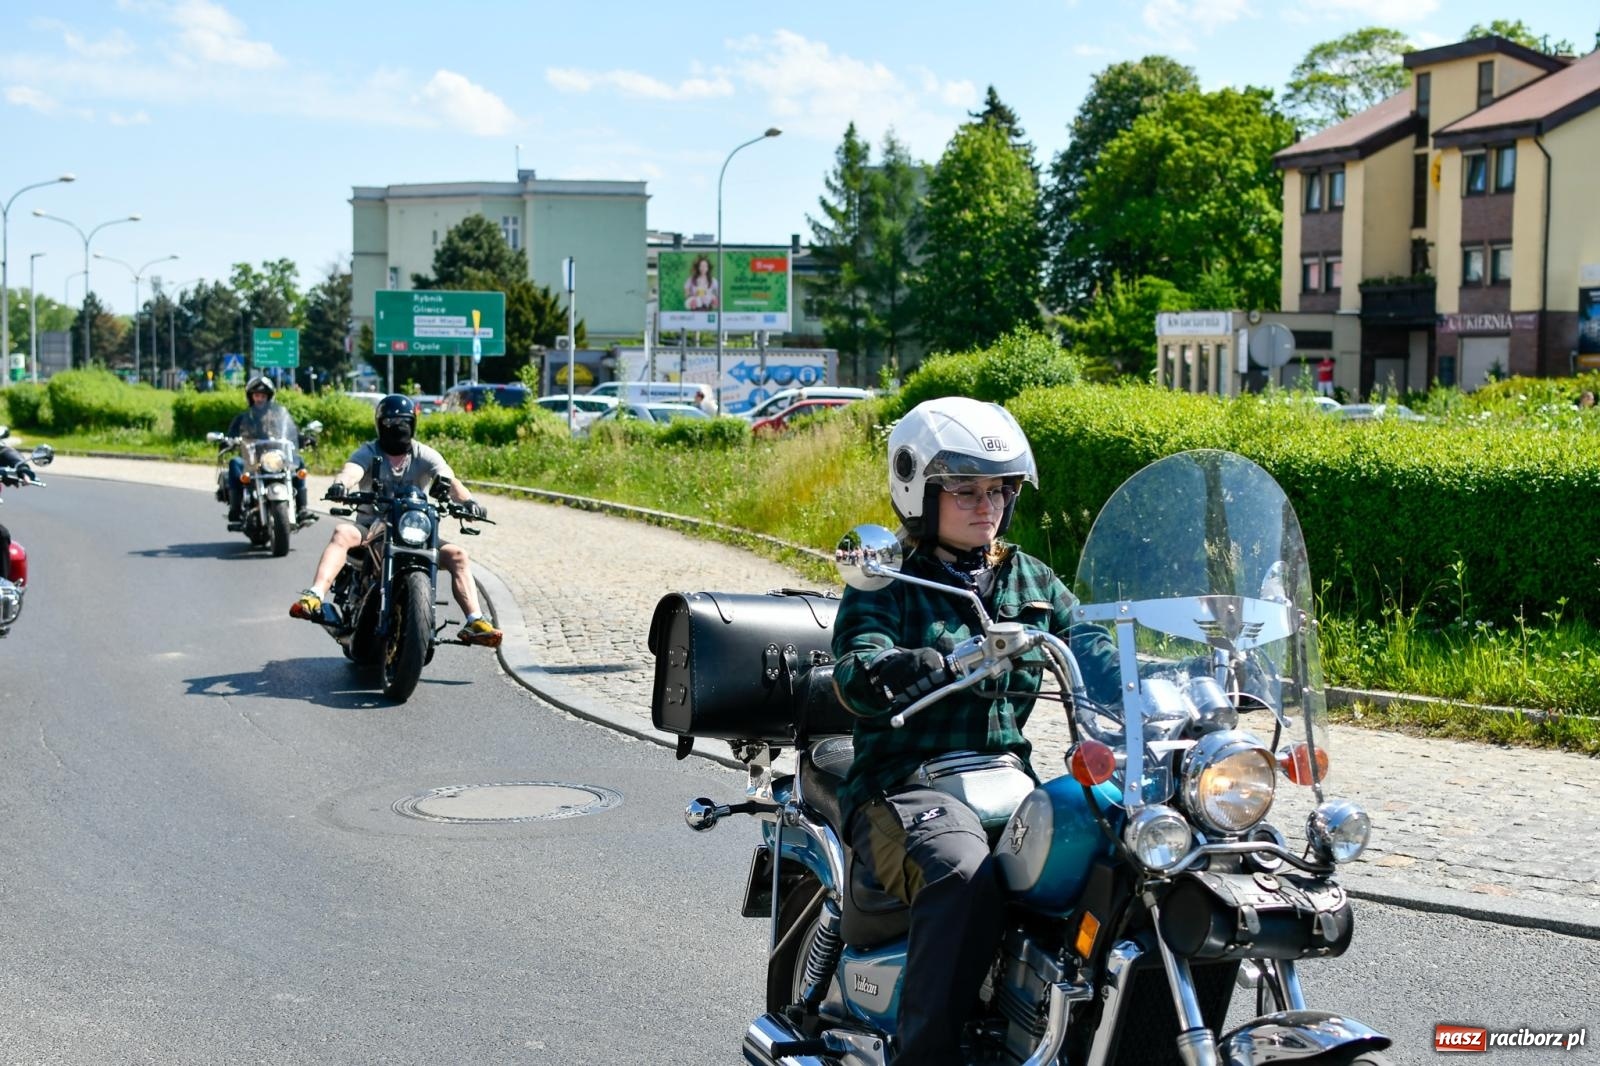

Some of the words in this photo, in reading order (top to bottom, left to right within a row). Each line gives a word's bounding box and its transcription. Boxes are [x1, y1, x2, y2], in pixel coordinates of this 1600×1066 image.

[413, 294, 443, 303] Rybnik
[413, 305, 446, 314] Gliwice
[1448, 314, 1513, 330] CUKIERNIA
[413, 342, 440, 351] Opole
